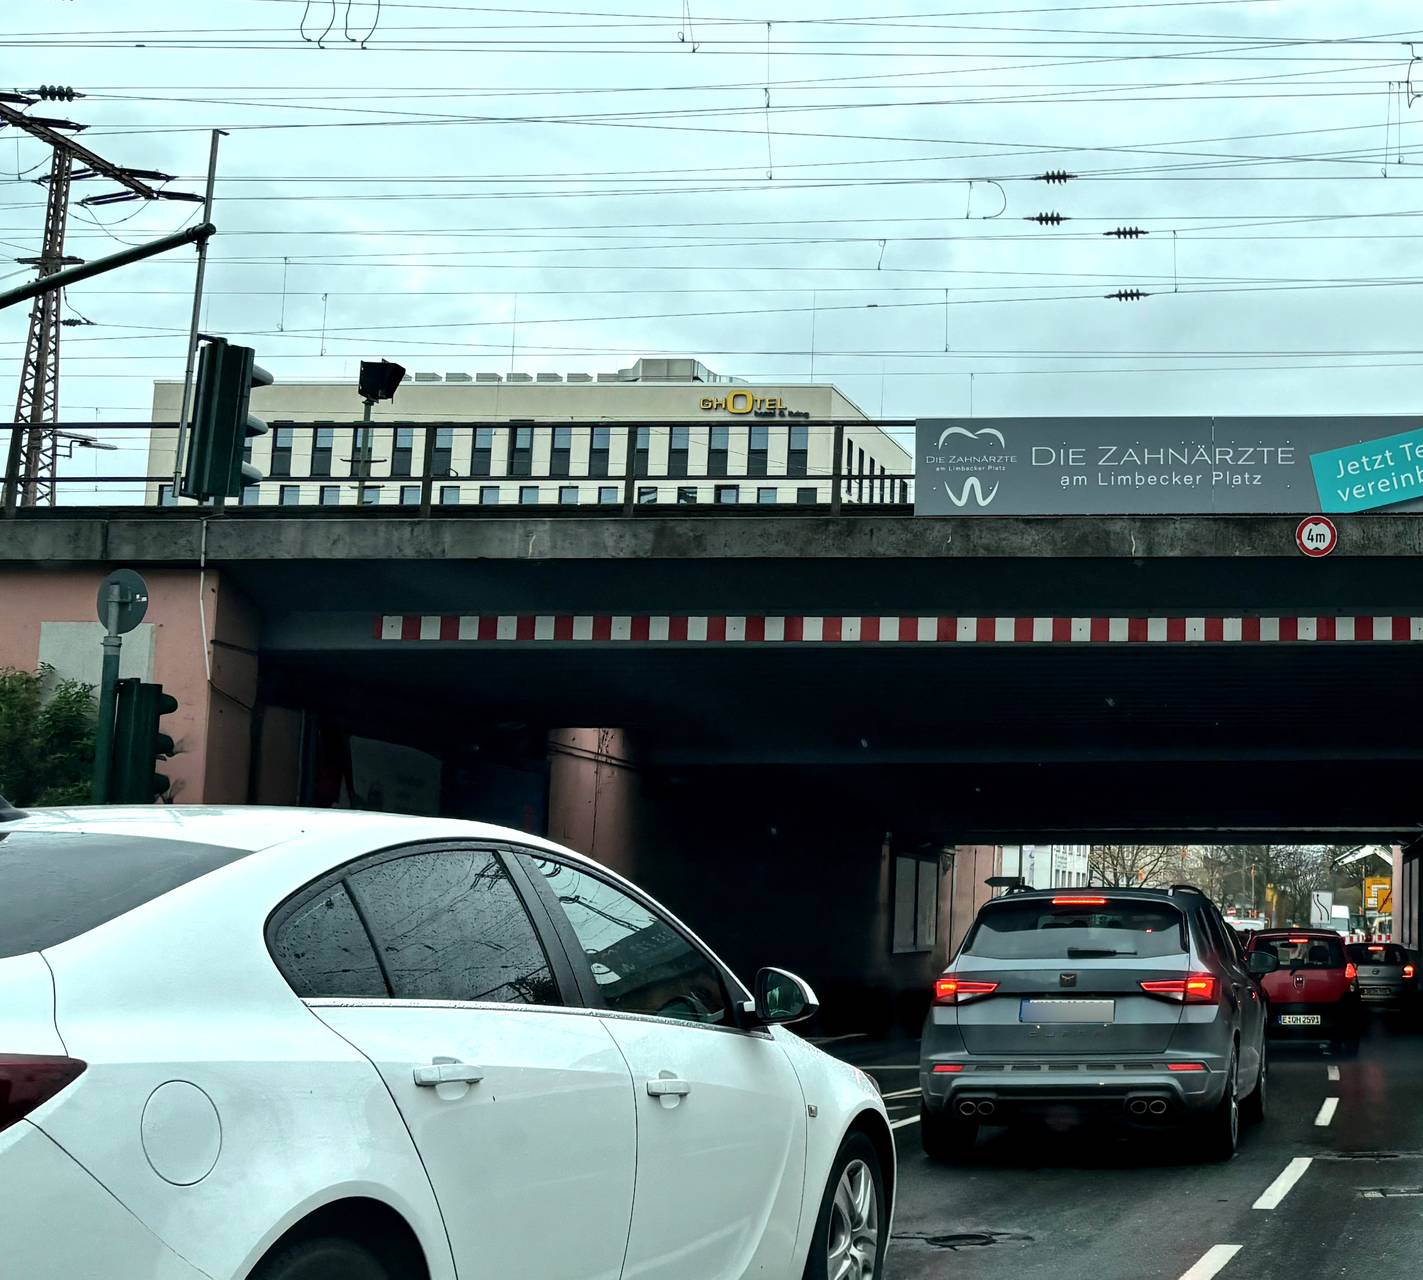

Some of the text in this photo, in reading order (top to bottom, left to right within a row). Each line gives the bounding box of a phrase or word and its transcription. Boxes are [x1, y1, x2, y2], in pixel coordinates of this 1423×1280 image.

[700, 390, 787, 415] GHOTEL
[926, 455, 945, 464] DIE
[1031, 444, 1297, 467] DIE ZAHNÄRZTE
[1336, 451, 1395, 479] Jetzt
[1060, 471, 1263, 488] am Limbecker Platz
[1307, 528, 1325, 543] 4m
